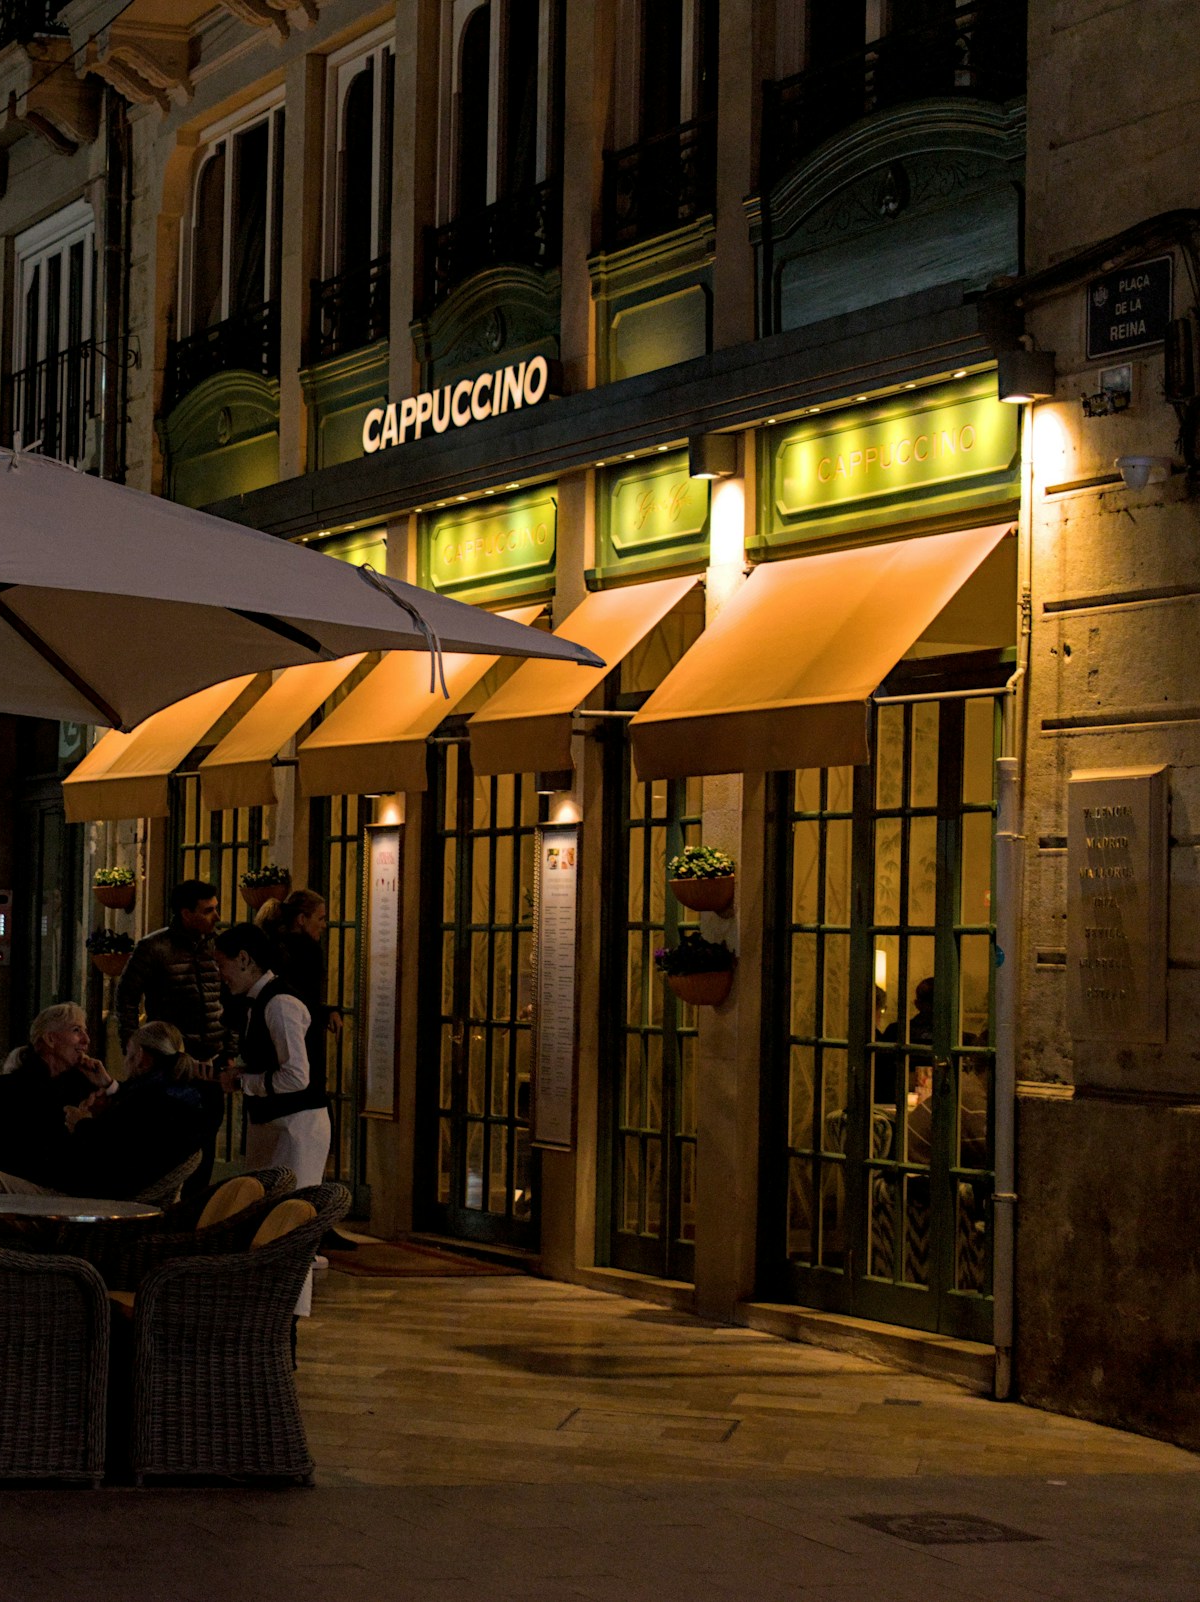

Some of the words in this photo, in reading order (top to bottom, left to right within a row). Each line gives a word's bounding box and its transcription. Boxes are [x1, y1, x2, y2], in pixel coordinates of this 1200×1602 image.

[1119, 273, 1150, 293] PLAÇA
[1115, 301, 1127, 315] DE
[1130, 299, 1141, 311] LA
[1110, 319, 1146, 341] REINA
[362, 355, 549, 455] CAPPUCCINO
[817, 424, 977, 484] CAPPUCCINO
[443, 522, 548, 566] CAPPUCCINO
[1085, 835, 1129, 849] MADRID
